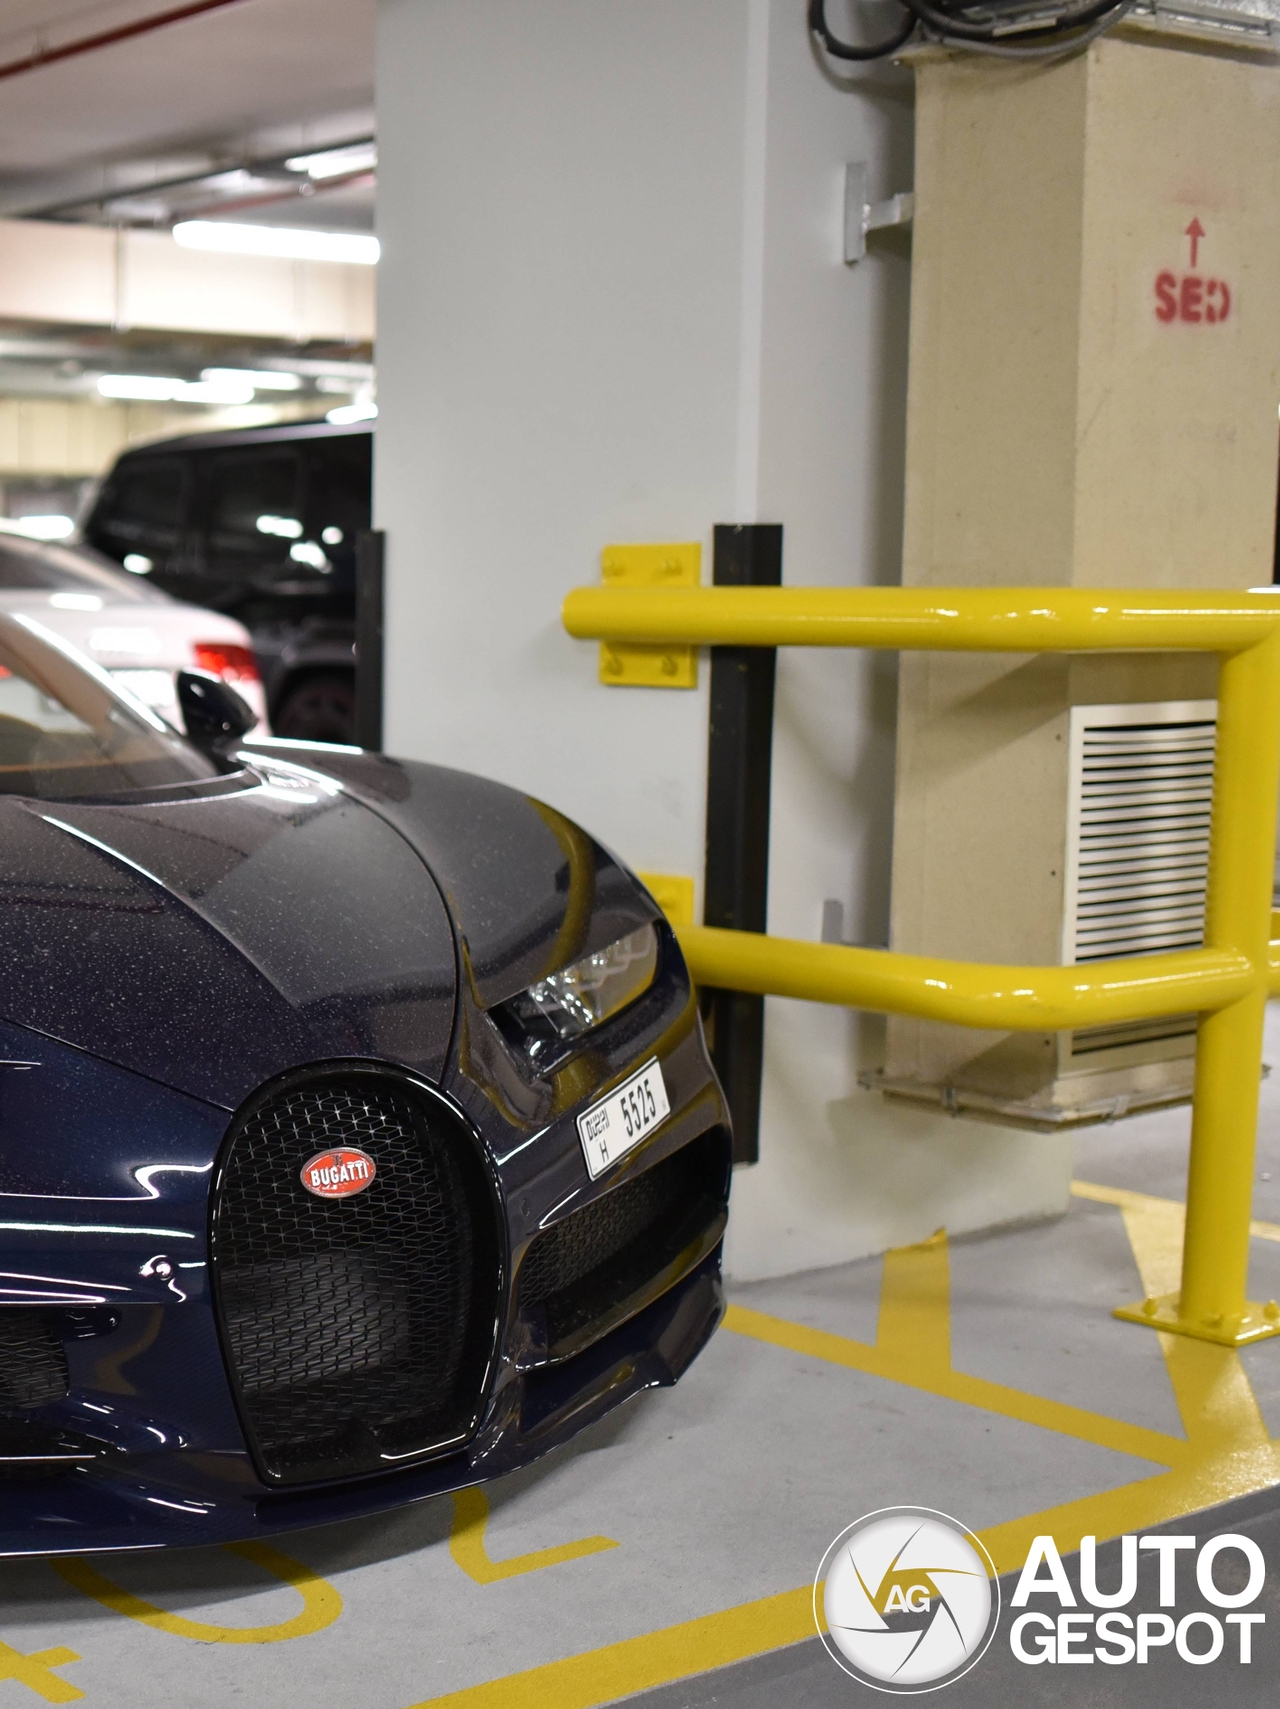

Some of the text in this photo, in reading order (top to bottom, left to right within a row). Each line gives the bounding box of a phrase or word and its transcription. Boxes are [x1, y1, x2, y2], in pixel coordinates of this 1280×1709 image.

[620, 1078, 656, 1138] 5525
[599, 1140, 610, 1163] H
[310, 1161, 369, 1187] BUGATTI
